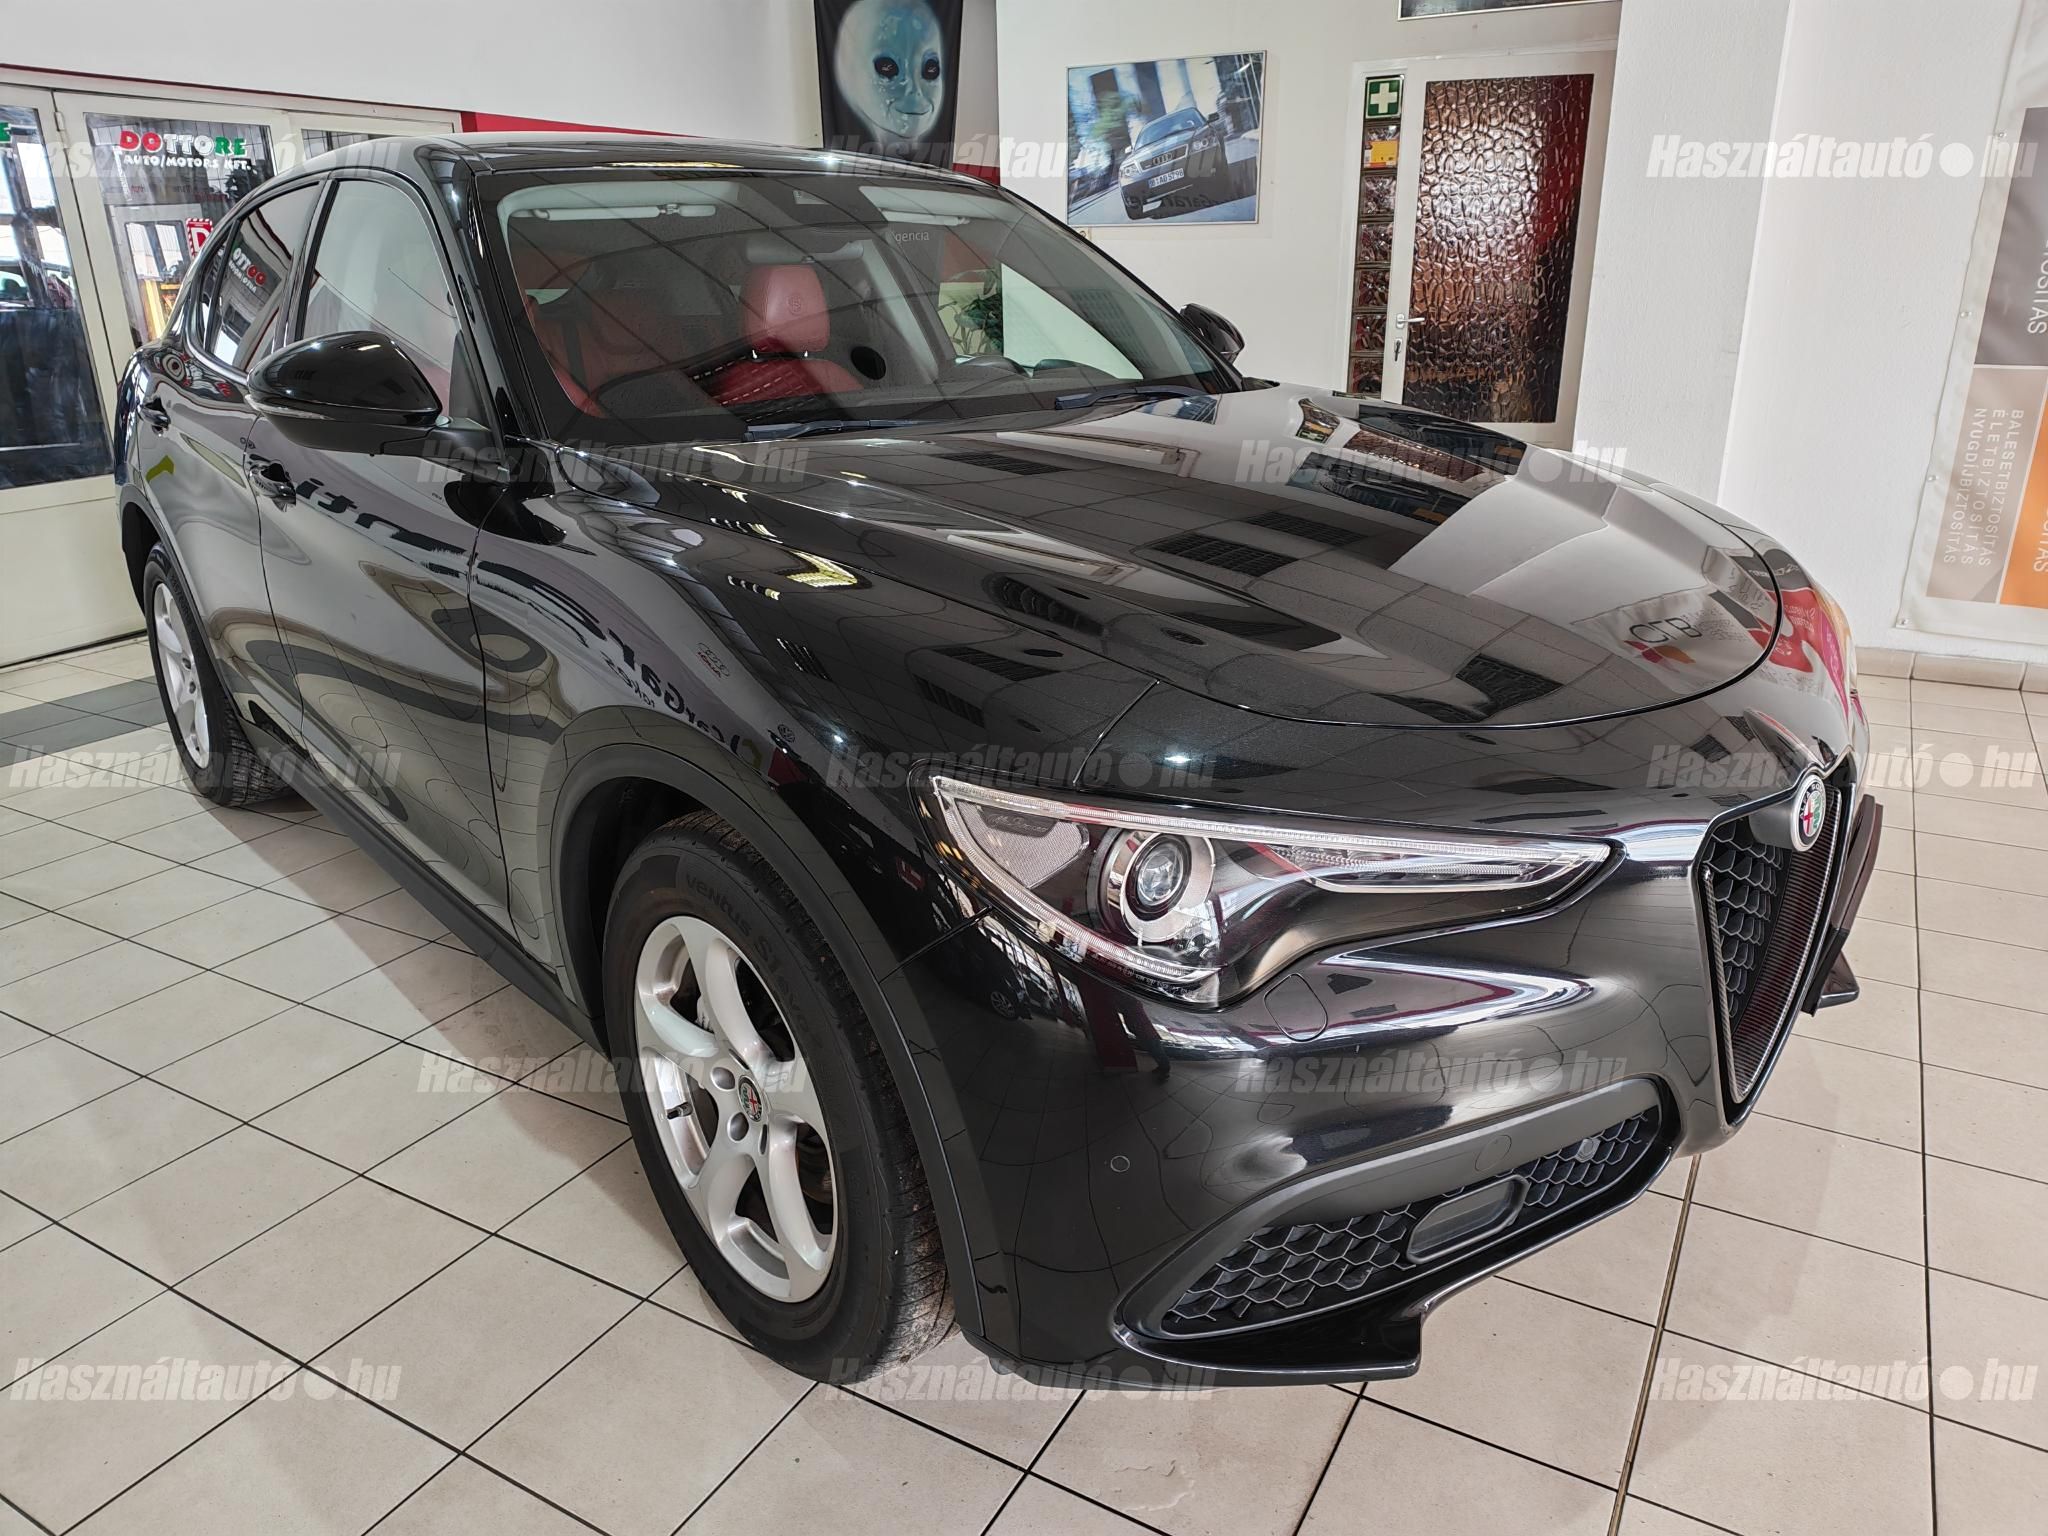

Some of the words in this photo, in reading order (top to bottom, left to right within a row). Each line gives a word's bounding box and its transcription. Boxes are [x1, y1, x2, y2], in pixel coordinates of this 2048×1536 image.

[119, 130, 247, 157] DOTTORE
[124, 154, 219, 169] AUTO/MOTORS
[1944, 408, 1987, 563] NYUGDÍJBIZTOSÍTÁS
[1960, 409, 2009, 564] ÉLETBIZTOSÍTÁS
[1978, 409, 2024, 566] BALESETBIZTOSÍTÁS
